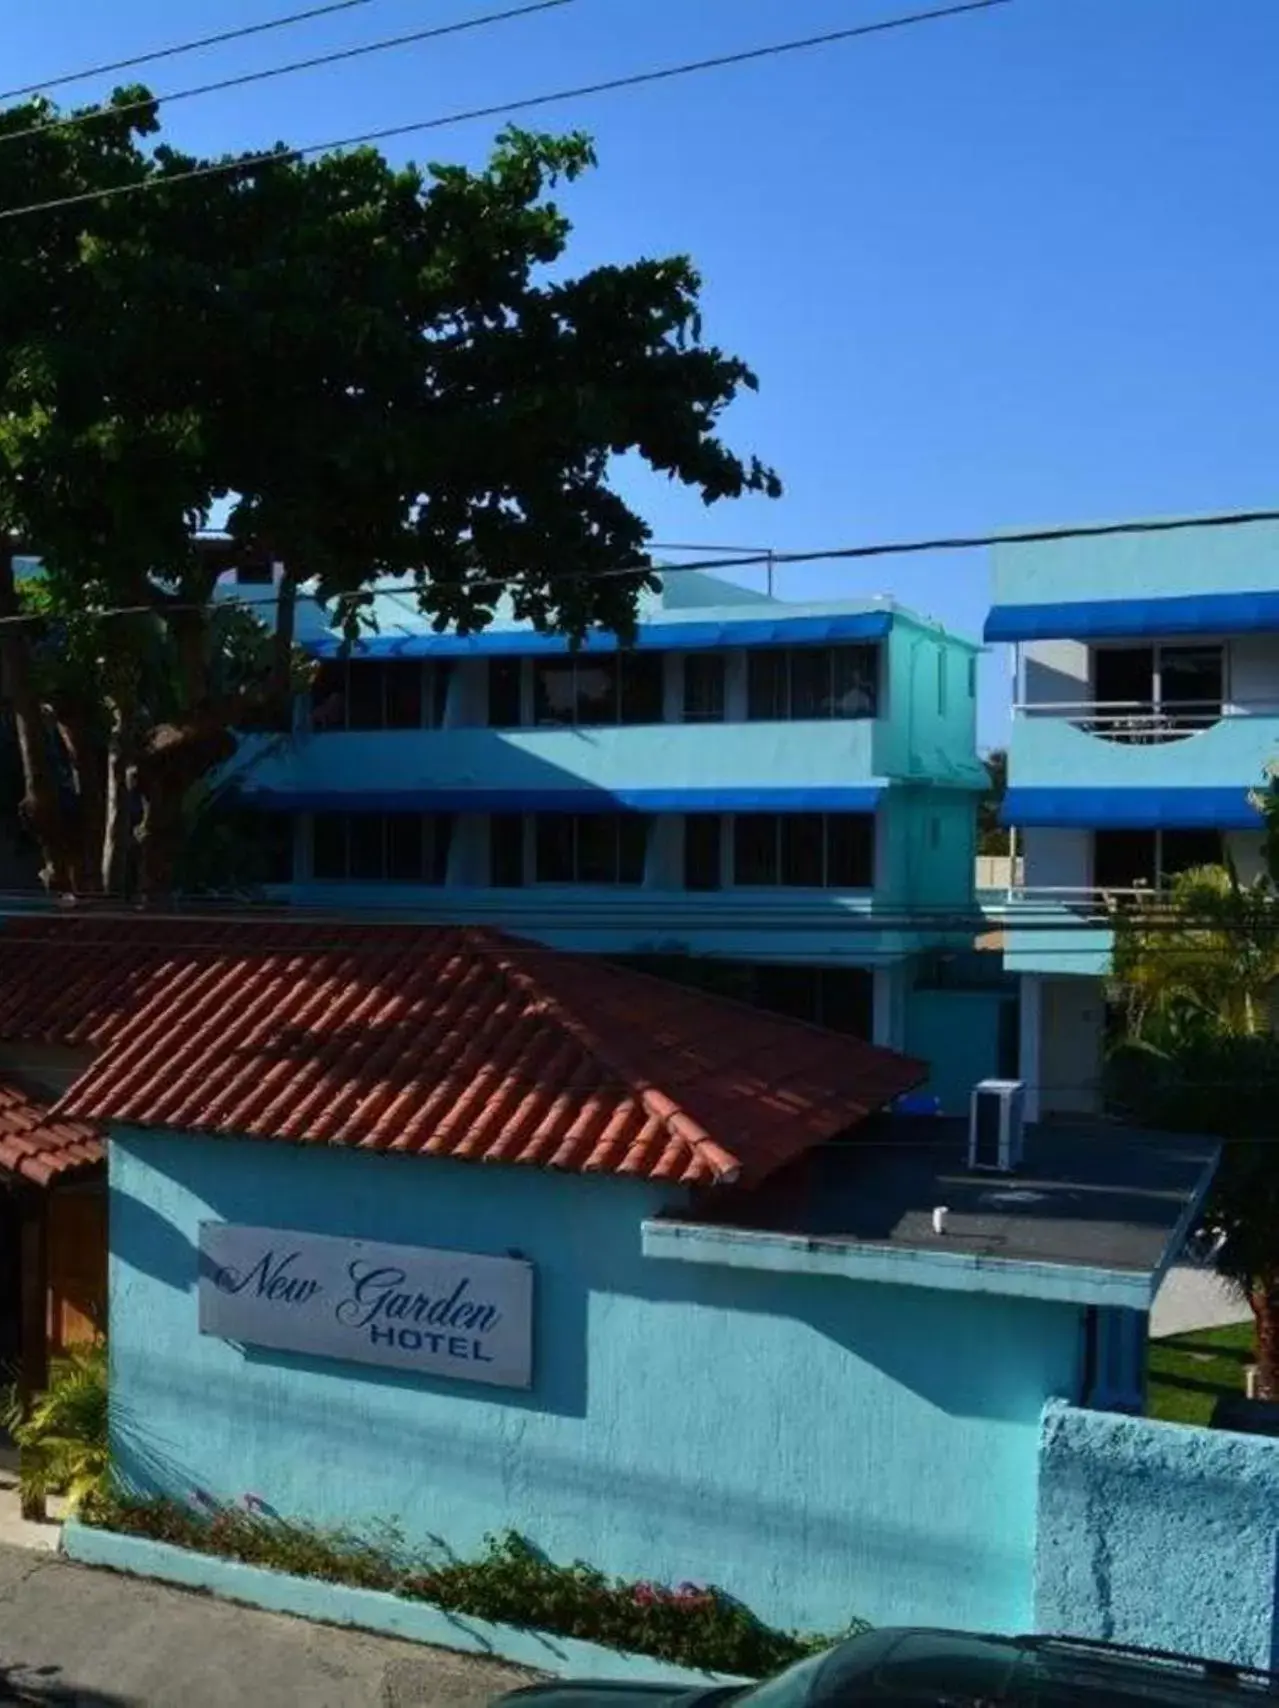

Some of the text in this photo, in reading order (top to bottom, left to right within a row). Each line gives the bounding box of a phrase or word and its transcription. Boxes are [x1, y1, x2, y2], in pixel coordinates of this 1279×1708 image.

[215, 1250, 502, 1332] New Garden
[369, 1324, 494, 1363] HOTEL
